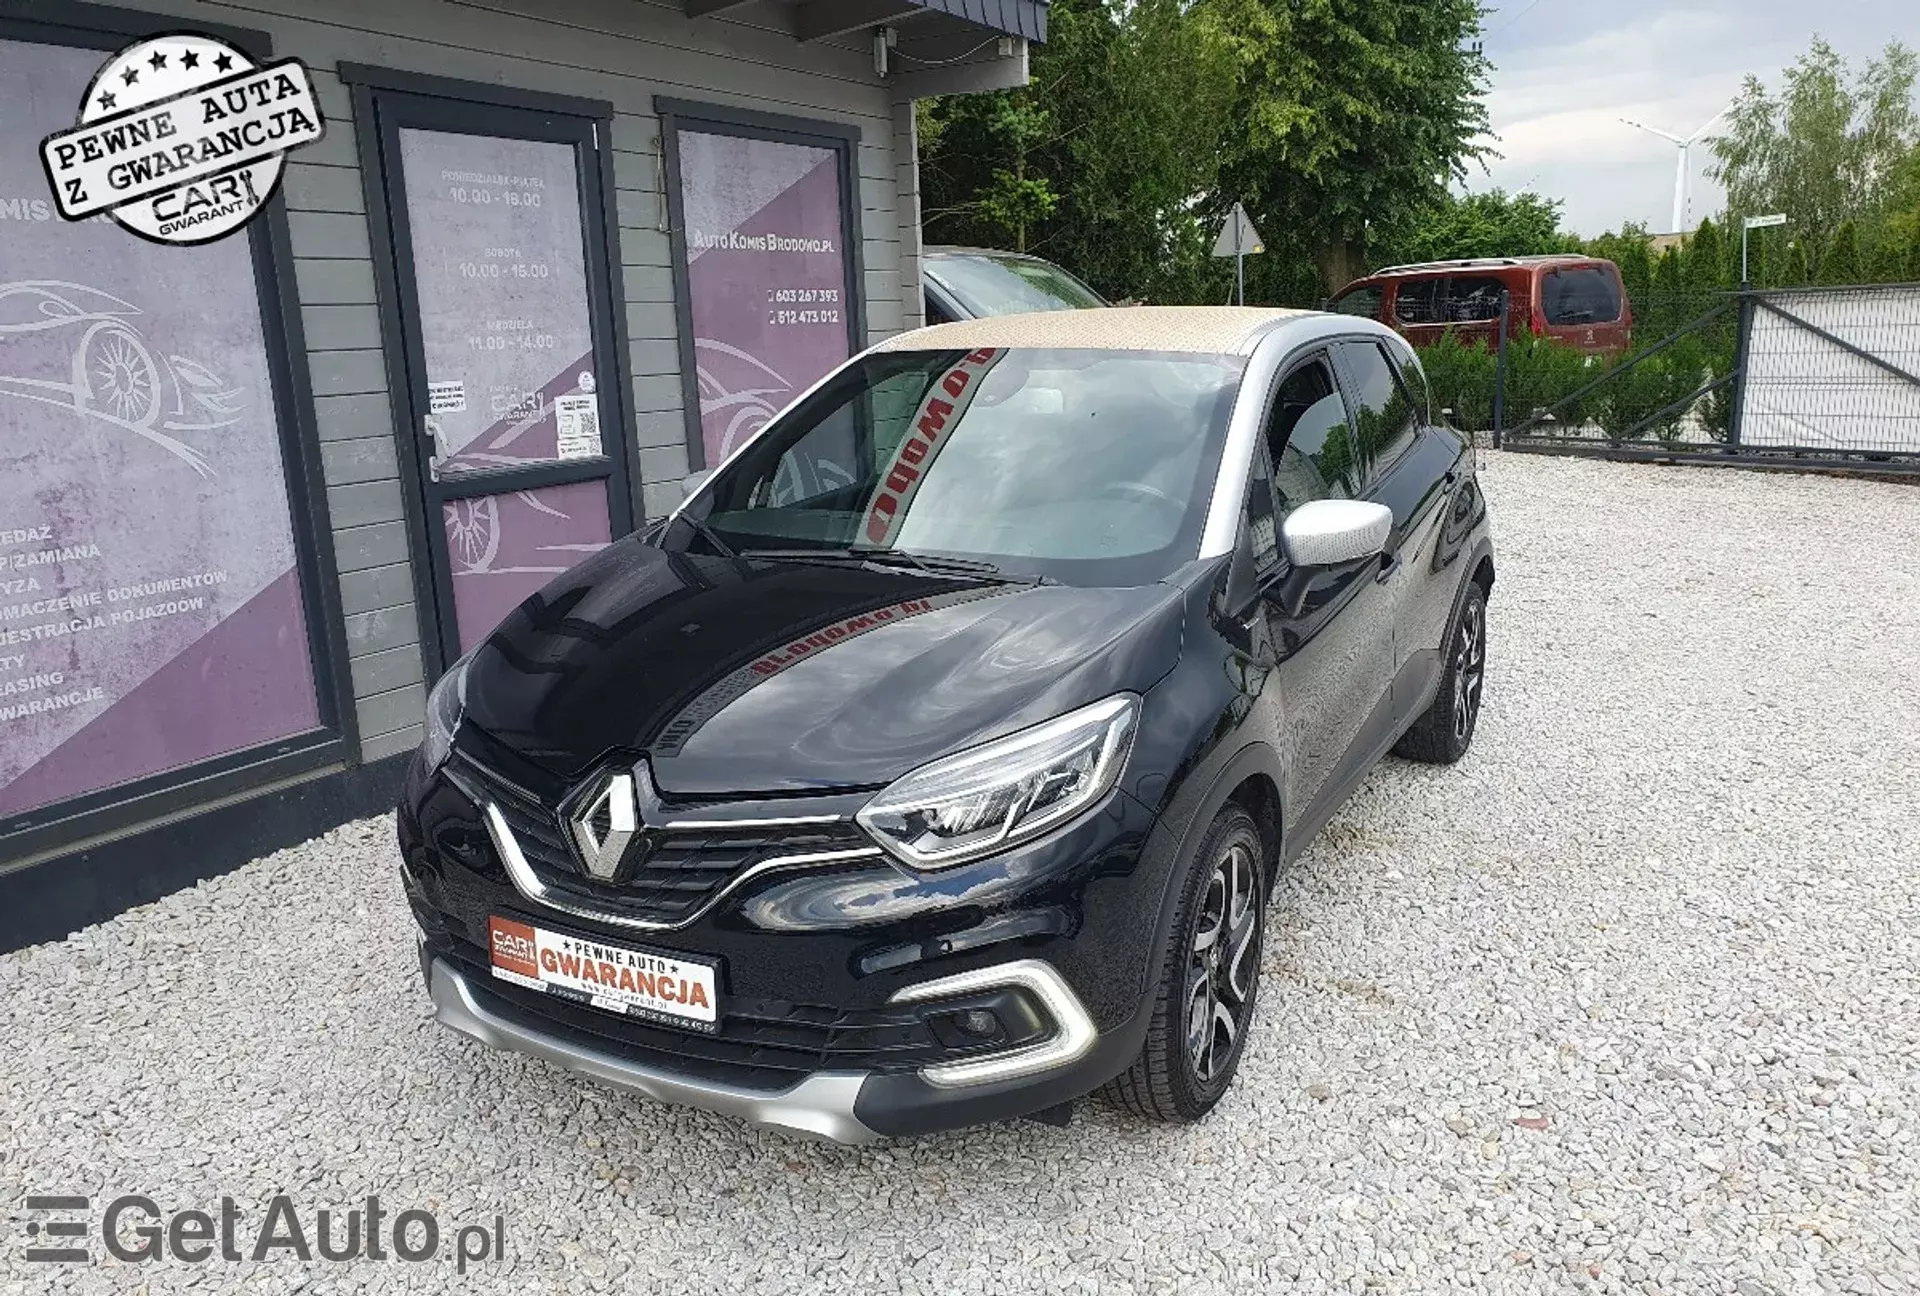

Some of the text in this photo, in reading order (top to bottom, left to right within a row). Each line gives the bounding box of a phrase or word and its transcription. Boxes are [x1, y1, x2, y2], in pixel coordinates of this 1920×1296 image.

[450, 187, 491, 204] 10.00
[484, 248, 521, 258] SOBOTA
[459, 262, 499, 278] 10.00
[511, 263, 549, 278] 15.00
[775, 289, 838, 302] 603 267 393
[778, 310, 839, 324] 512 473 012
[0, 591, 102, 621] MACZENIE
[574, 942, 666, 975] PEWNE AUTO
[540, 947, 710, 1009] GWARANCJA
